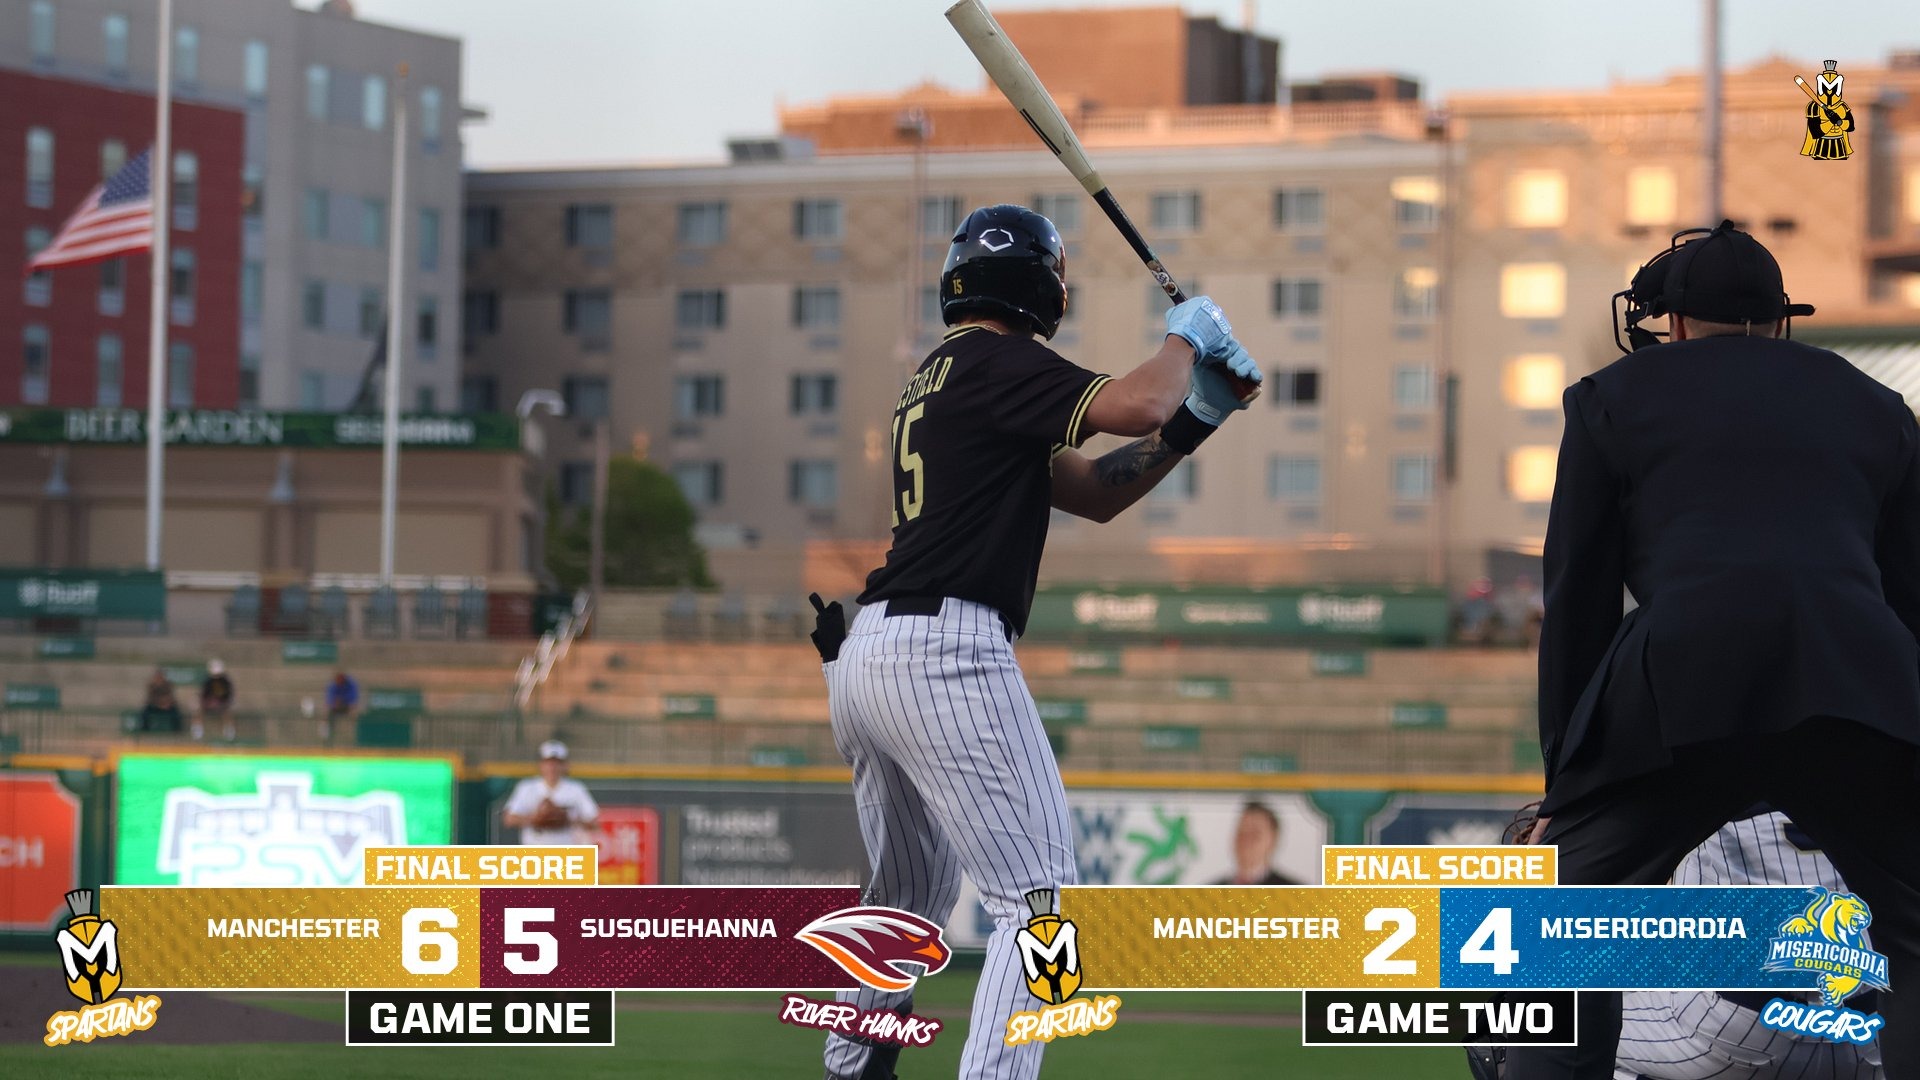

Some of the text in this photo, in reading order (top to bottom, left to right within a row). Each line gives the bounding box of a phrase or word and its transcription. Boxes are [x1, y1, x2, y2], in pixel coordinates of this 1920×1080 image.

[953, 278, 963, 295] 15
[64, 408, 142, 442] BEER
[887, 402, 925, 528] 15
